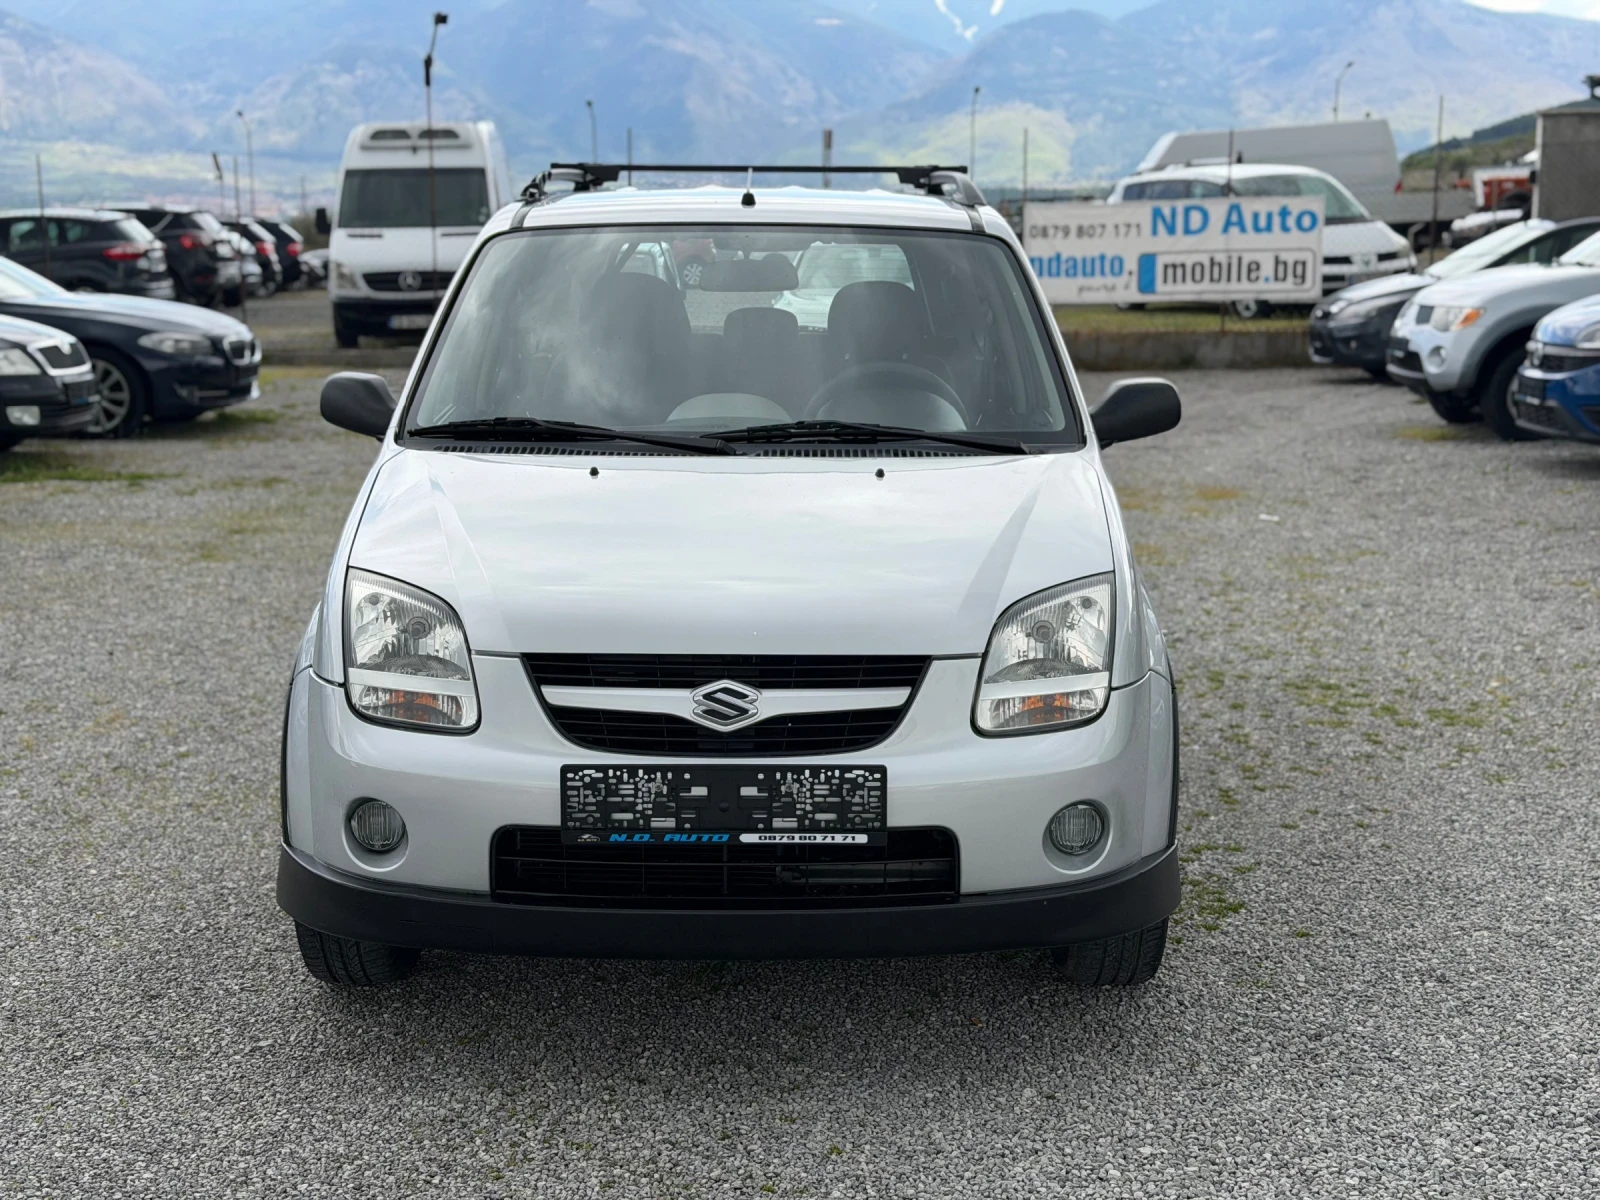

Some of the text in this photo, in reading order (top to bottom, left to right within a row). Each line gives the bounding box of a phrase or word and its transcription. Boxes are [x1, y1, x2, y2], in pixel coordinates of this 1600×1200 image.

[1150, 202, 1319, 237] ND Auto
[1029, 222, 1141, 239] 0879 807 171
[1163, 254, 1307, 287] mobile.bg
[663, 833, 730, 842] AUTO
[758, 834, 795, 842] 0879
